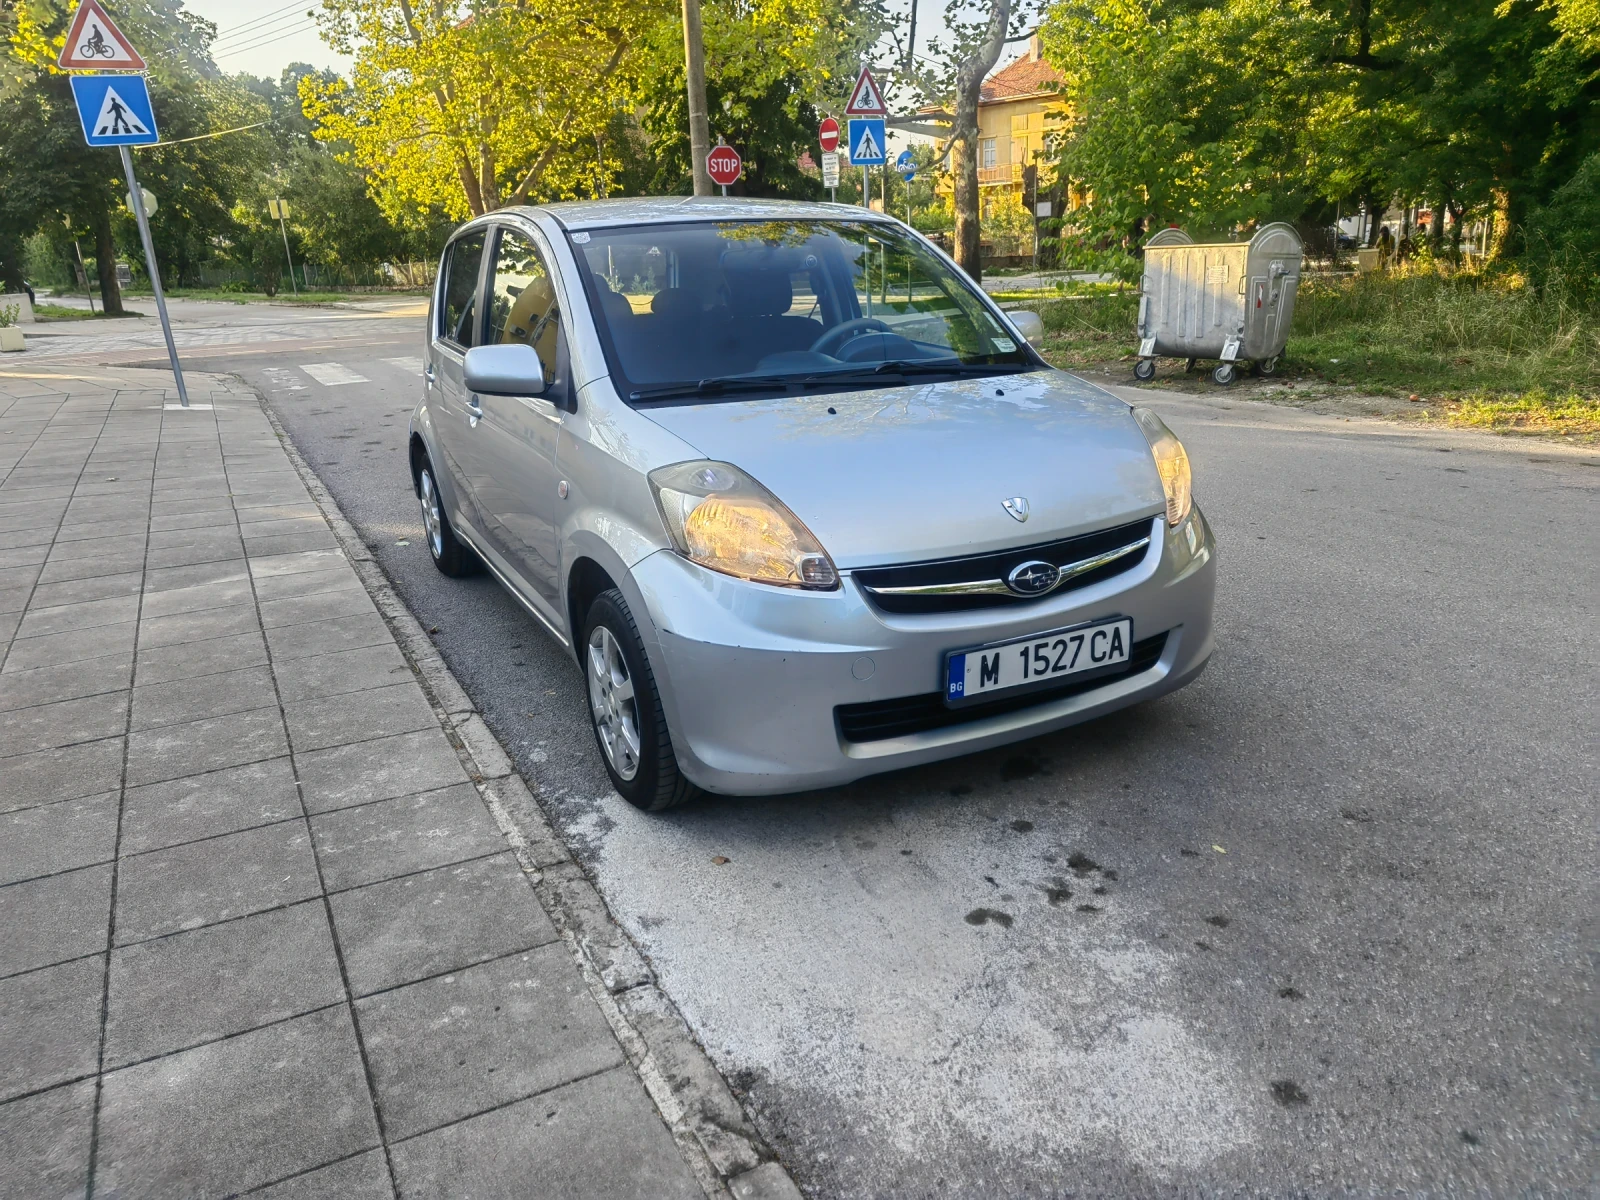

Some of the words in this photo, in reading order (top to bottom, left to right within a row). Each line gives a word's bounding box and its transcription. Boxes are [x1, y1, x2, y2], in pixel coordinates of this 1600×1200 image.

[711, 158, 738, 173] STOP
[979, 652, 1000, 688] M
[1019, 634, 1084, 679] 1527
[1091, 626, 1124, 663] CA
[950, 682, 963, 693] BG
